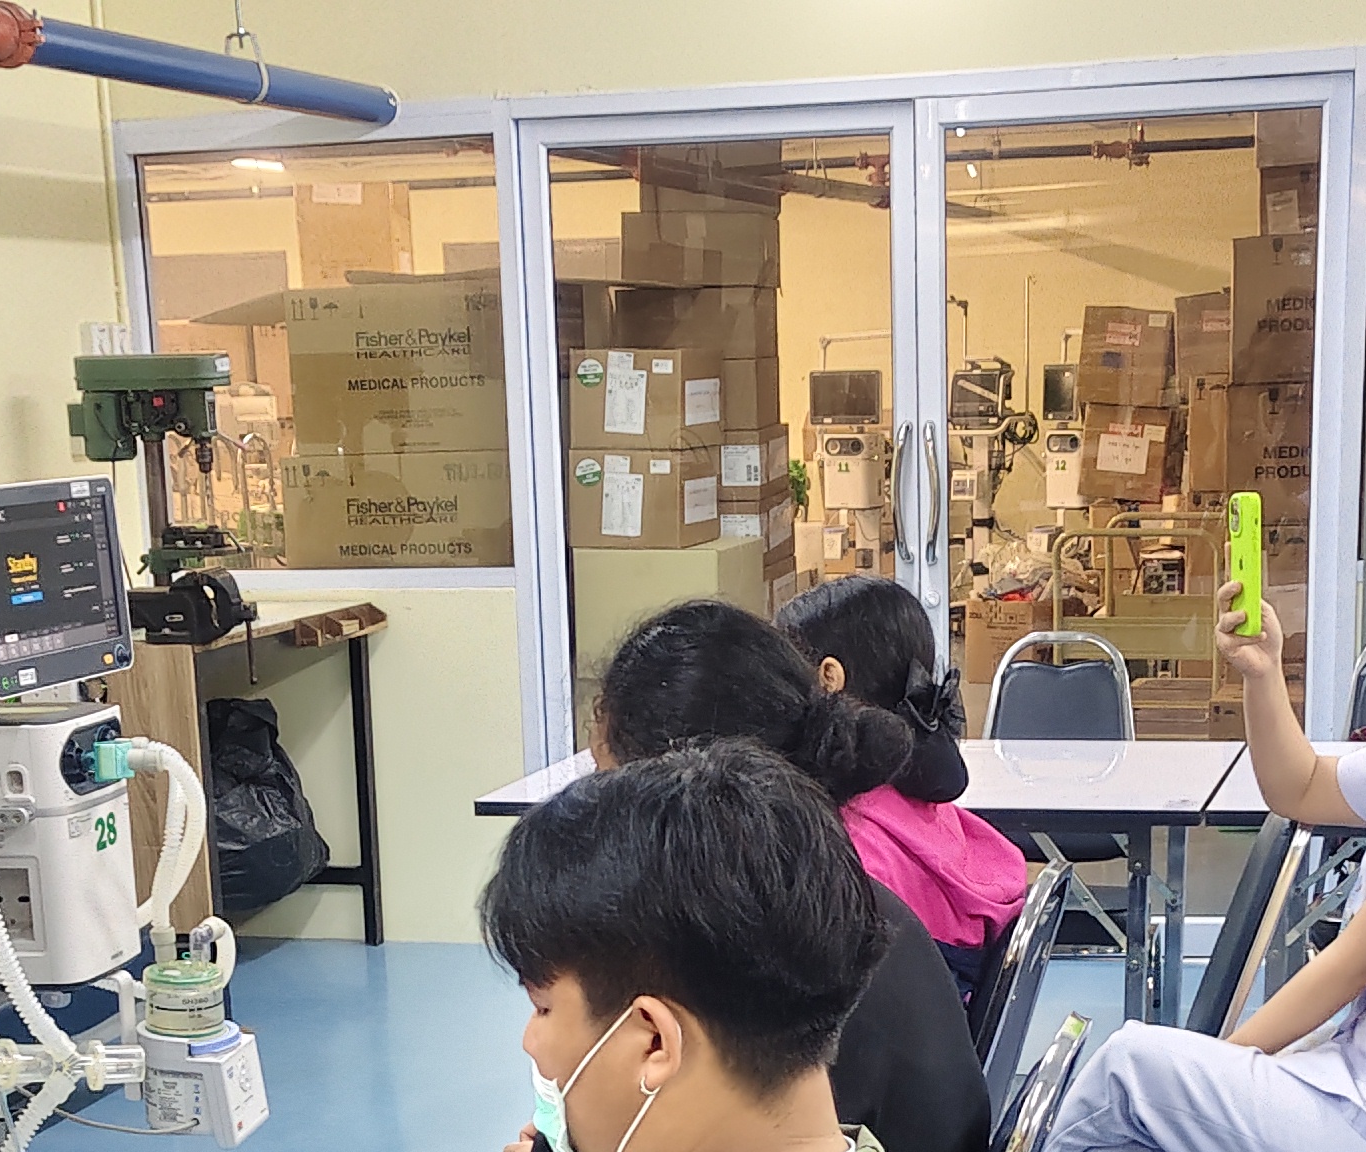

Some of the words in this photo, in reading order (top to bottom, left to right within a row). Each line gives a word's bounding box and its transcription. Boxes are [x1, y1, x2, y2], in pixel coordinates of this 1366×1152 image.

[347, 378, 408, 391] MEDICAL
[410, 374, 485, 389] PRODUCTS
[1054, 459, 1067, 471] 12
[339, 544, 397, 557] MEDICAL
[400, 541, 473, 556] PRODUCTS
[94, 811, 118, 852] 28
